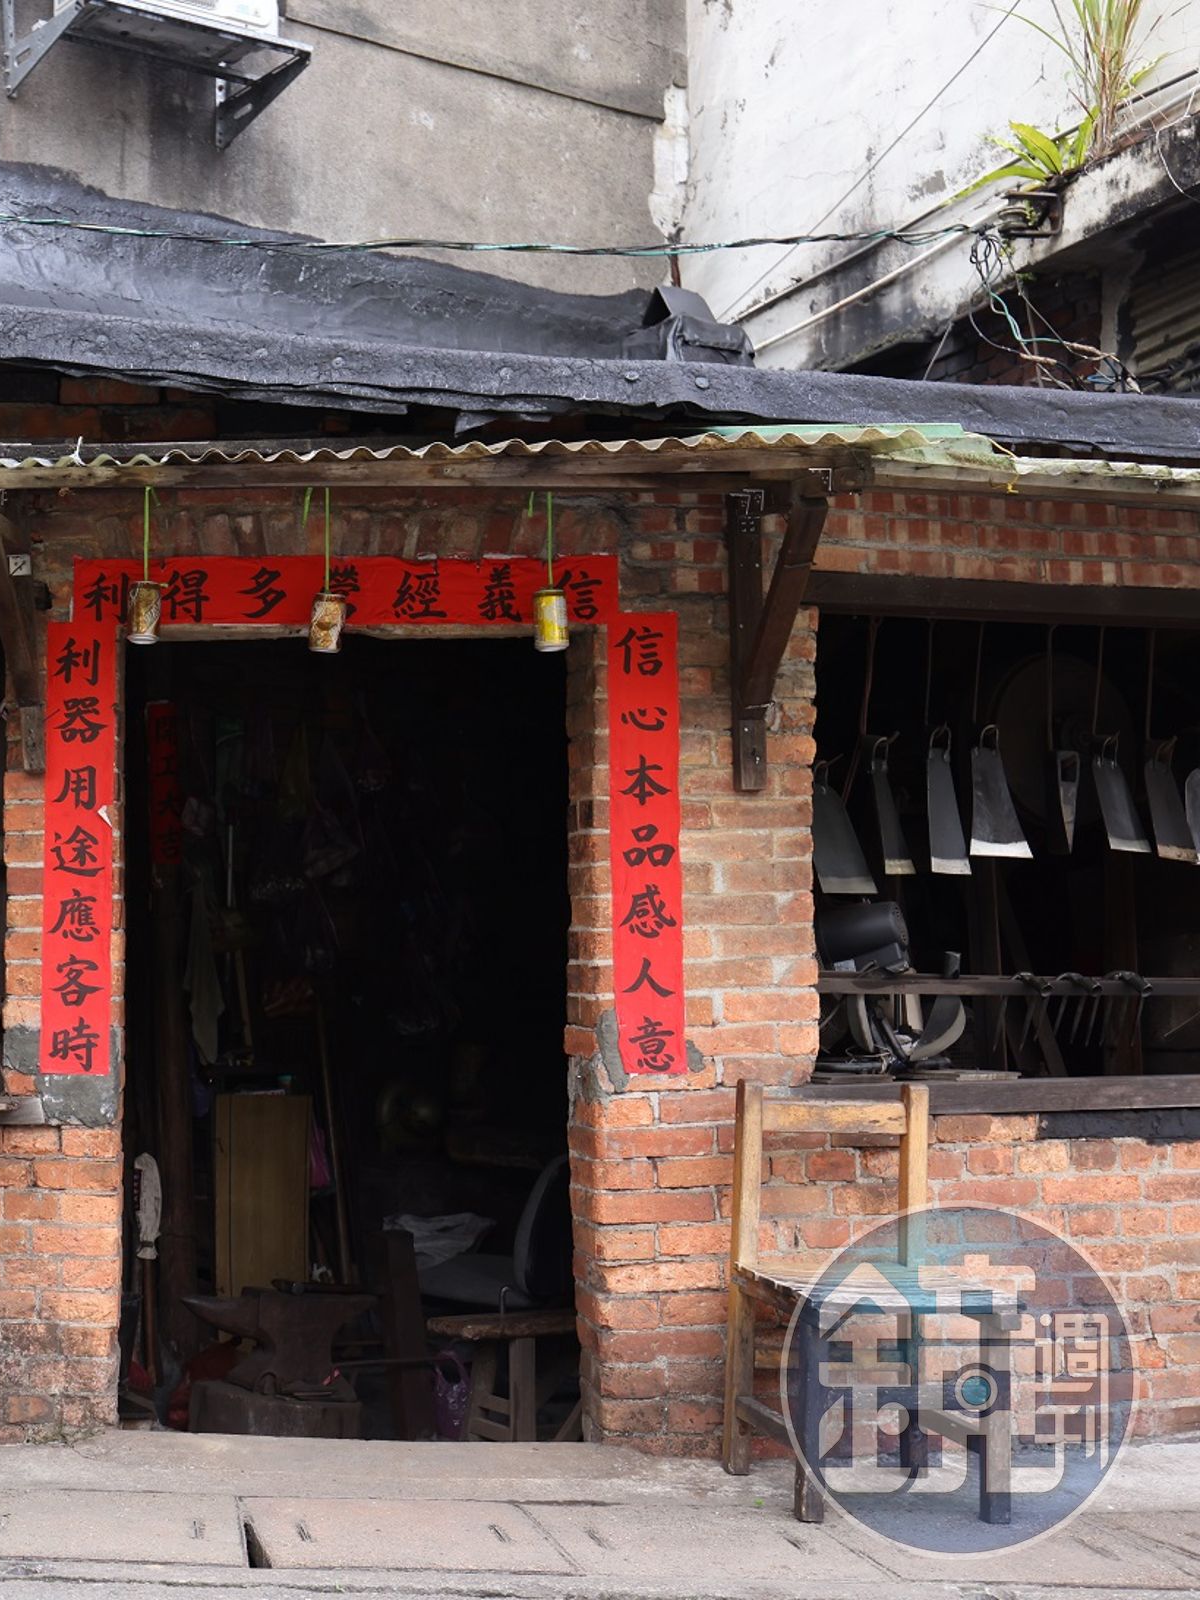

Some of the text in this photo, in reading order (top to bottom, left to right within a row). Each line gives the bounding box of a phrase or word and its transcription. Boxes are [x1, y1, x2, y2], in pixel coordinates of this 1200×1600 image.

[49, 638, 107, 1071] 利器用途應客時
[614, 627, 676, 1071] 信心本品感人意
